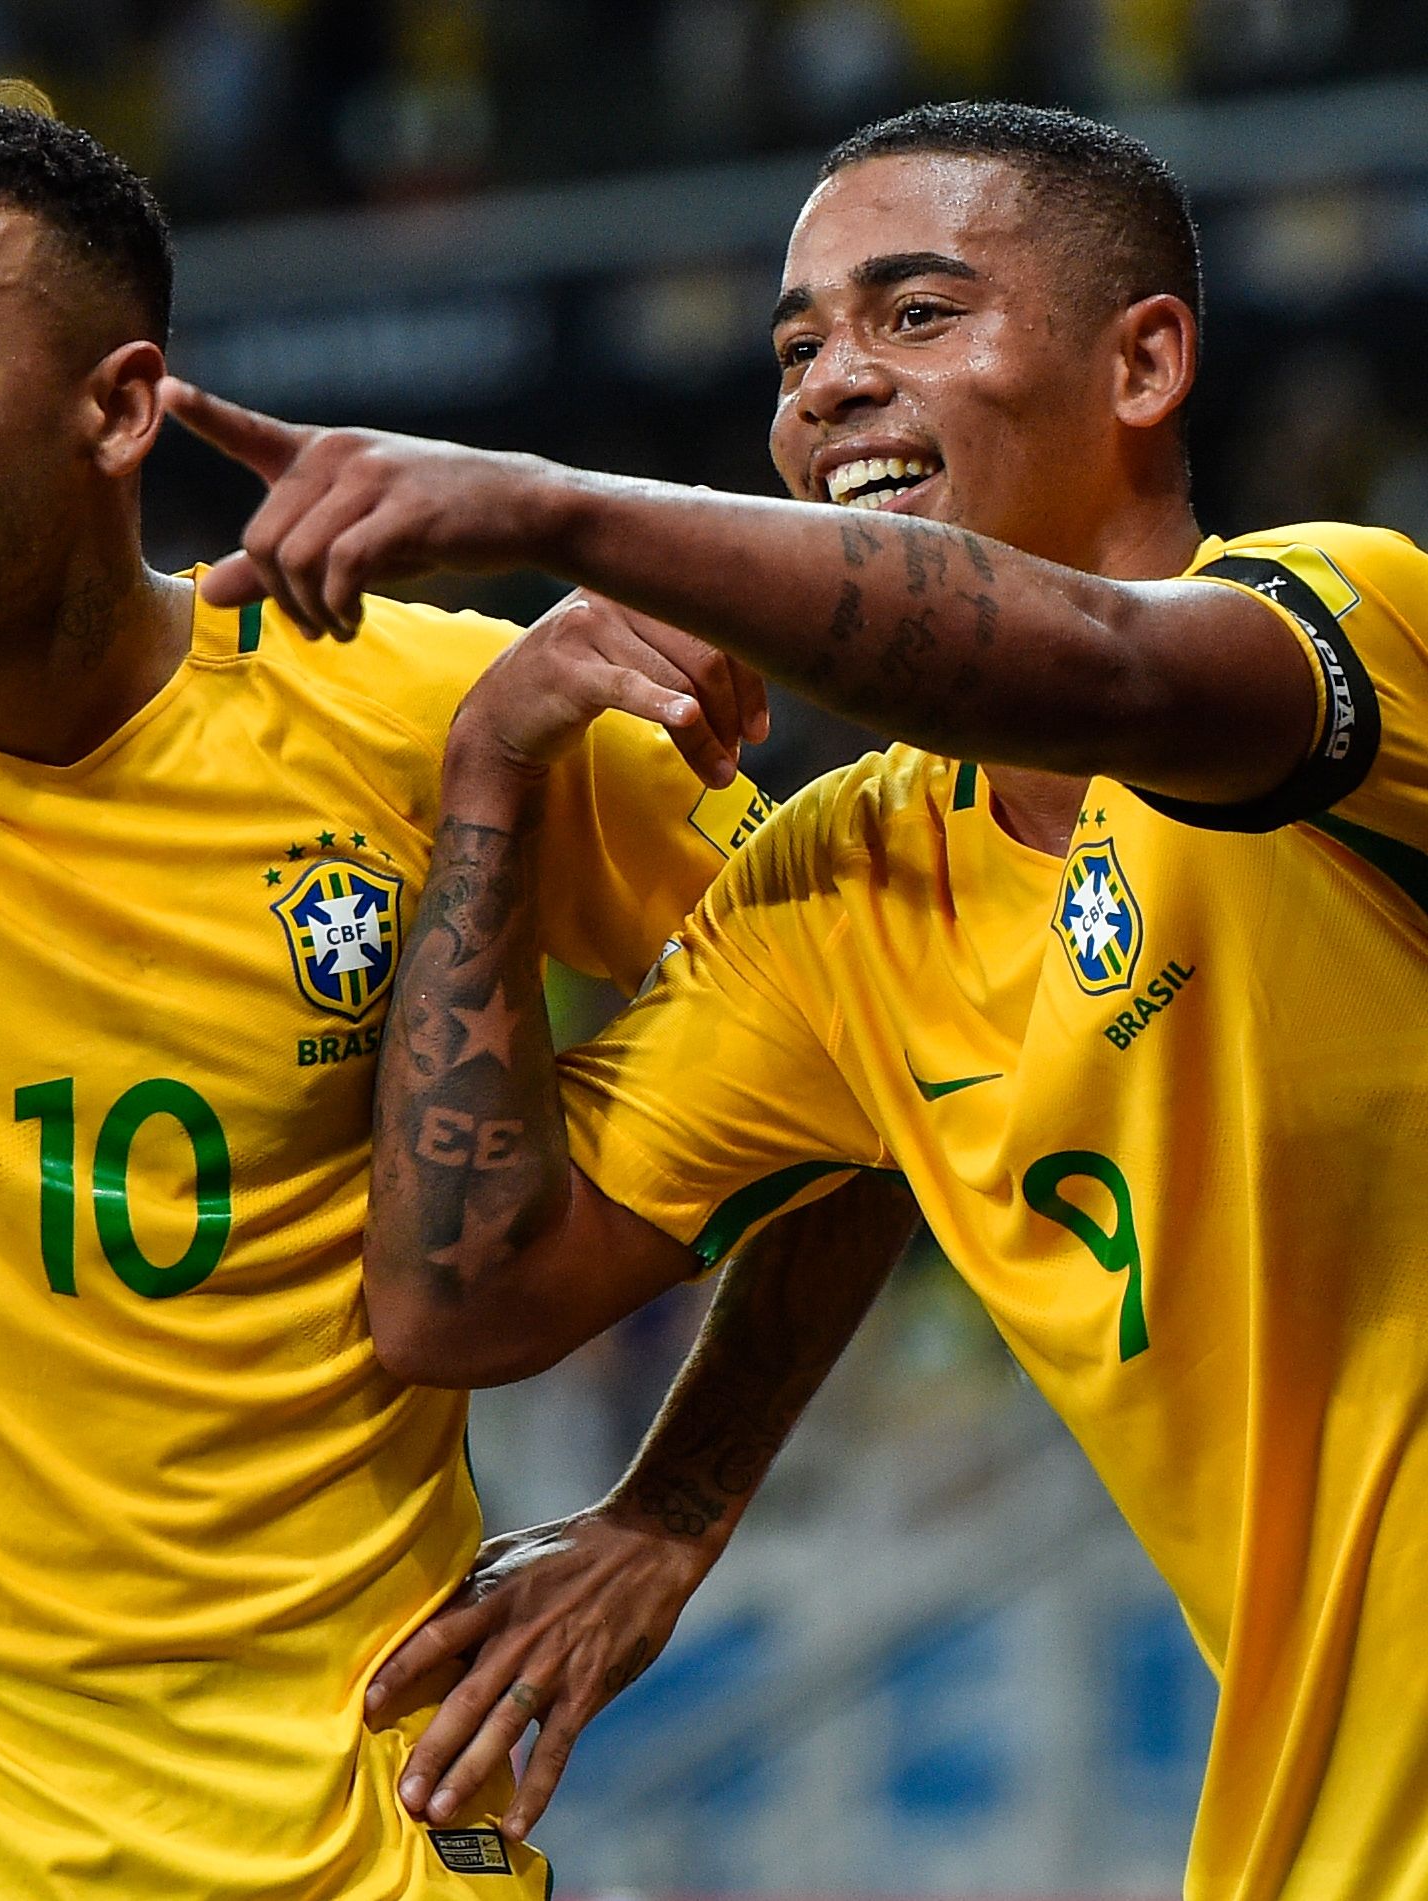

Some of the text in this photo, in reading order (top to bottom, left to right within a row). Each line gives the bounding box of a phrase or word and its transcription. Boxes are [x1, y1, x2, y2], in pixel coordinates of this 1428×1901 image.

[326, 921, 367, 945] CBF
[1081, 895, 1107, 932] CBF
[1103, 960, 1196, 1051] BRASIL
[297, 1025, 381, 1066] BRAS
[14, 1076, 232, 1299] 10
[1022, 1150, 1150, 1363] 9
